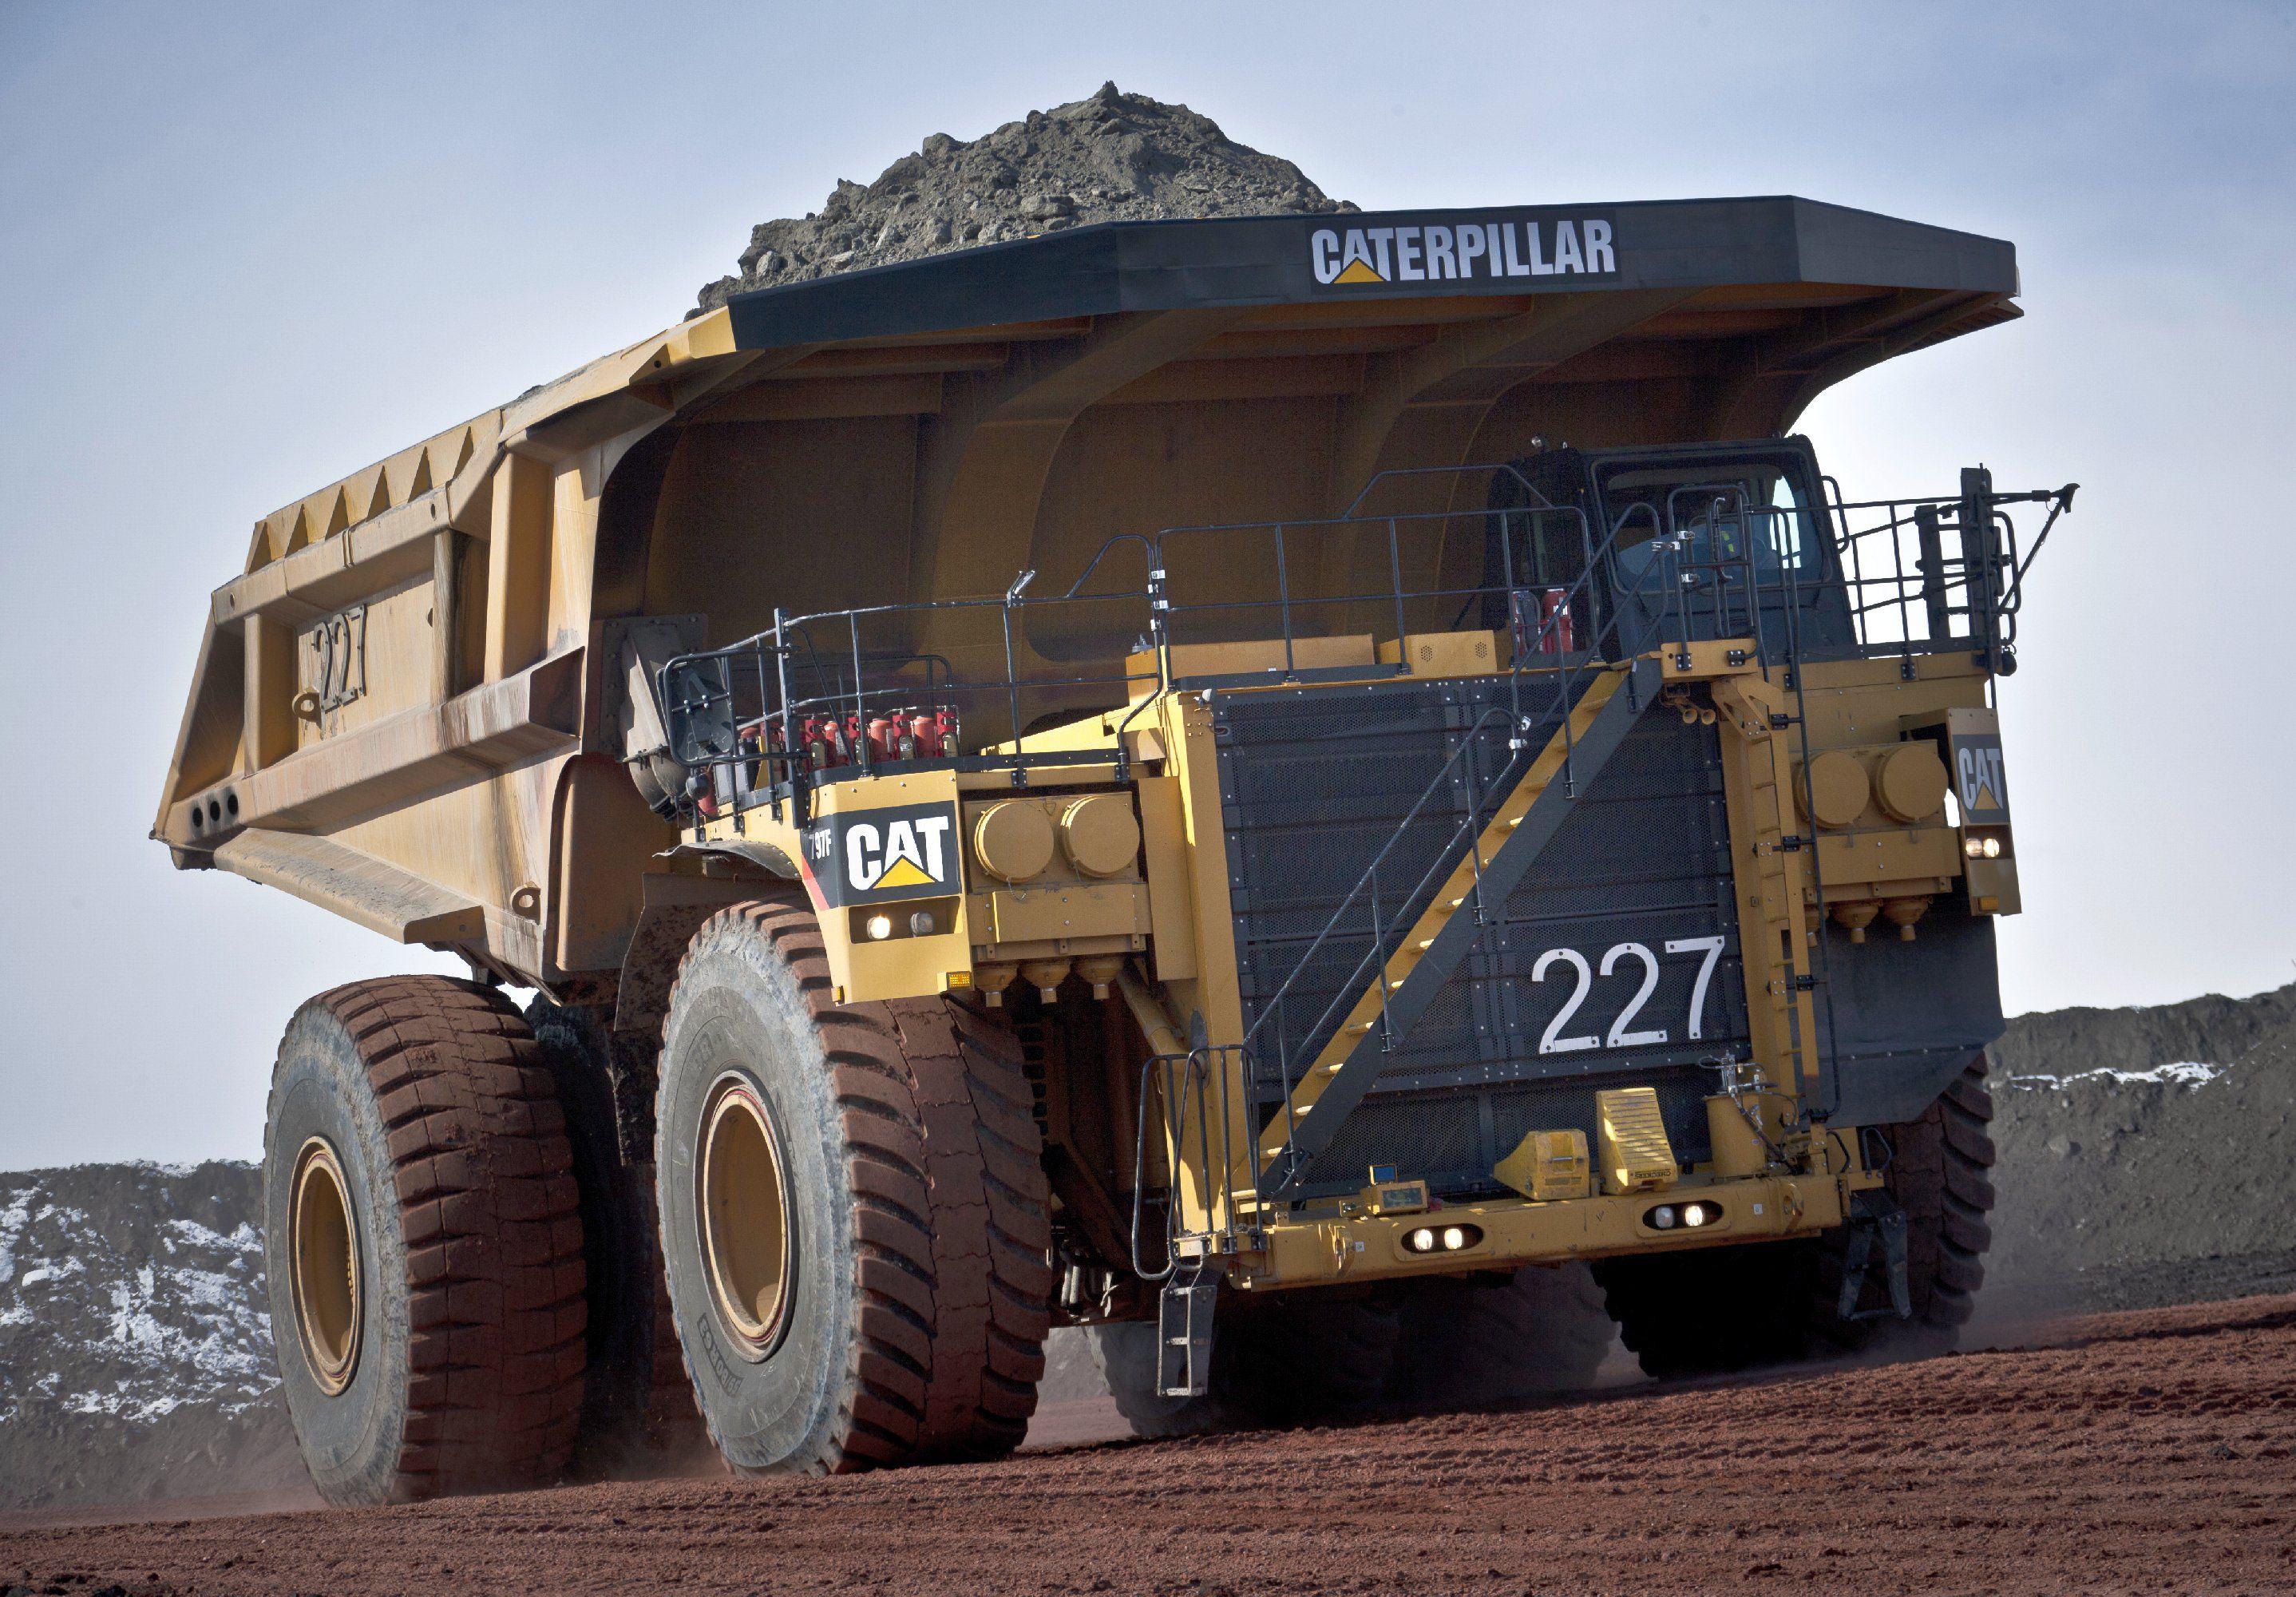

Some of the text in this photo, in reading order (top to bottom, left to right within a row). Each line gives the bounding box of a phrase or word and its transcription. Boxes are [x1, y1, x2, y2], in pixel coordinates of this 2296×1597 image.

[1311, 220, 1615, 284] CATERPILLAR
[314, 604, 367, 713] 227
[1958, 747, 2004, 810] CAT
[808, 829, 832, 860] 797F
[846, 816, 948, 890] CAT
[1532, 935, 1725, 1054] 227
